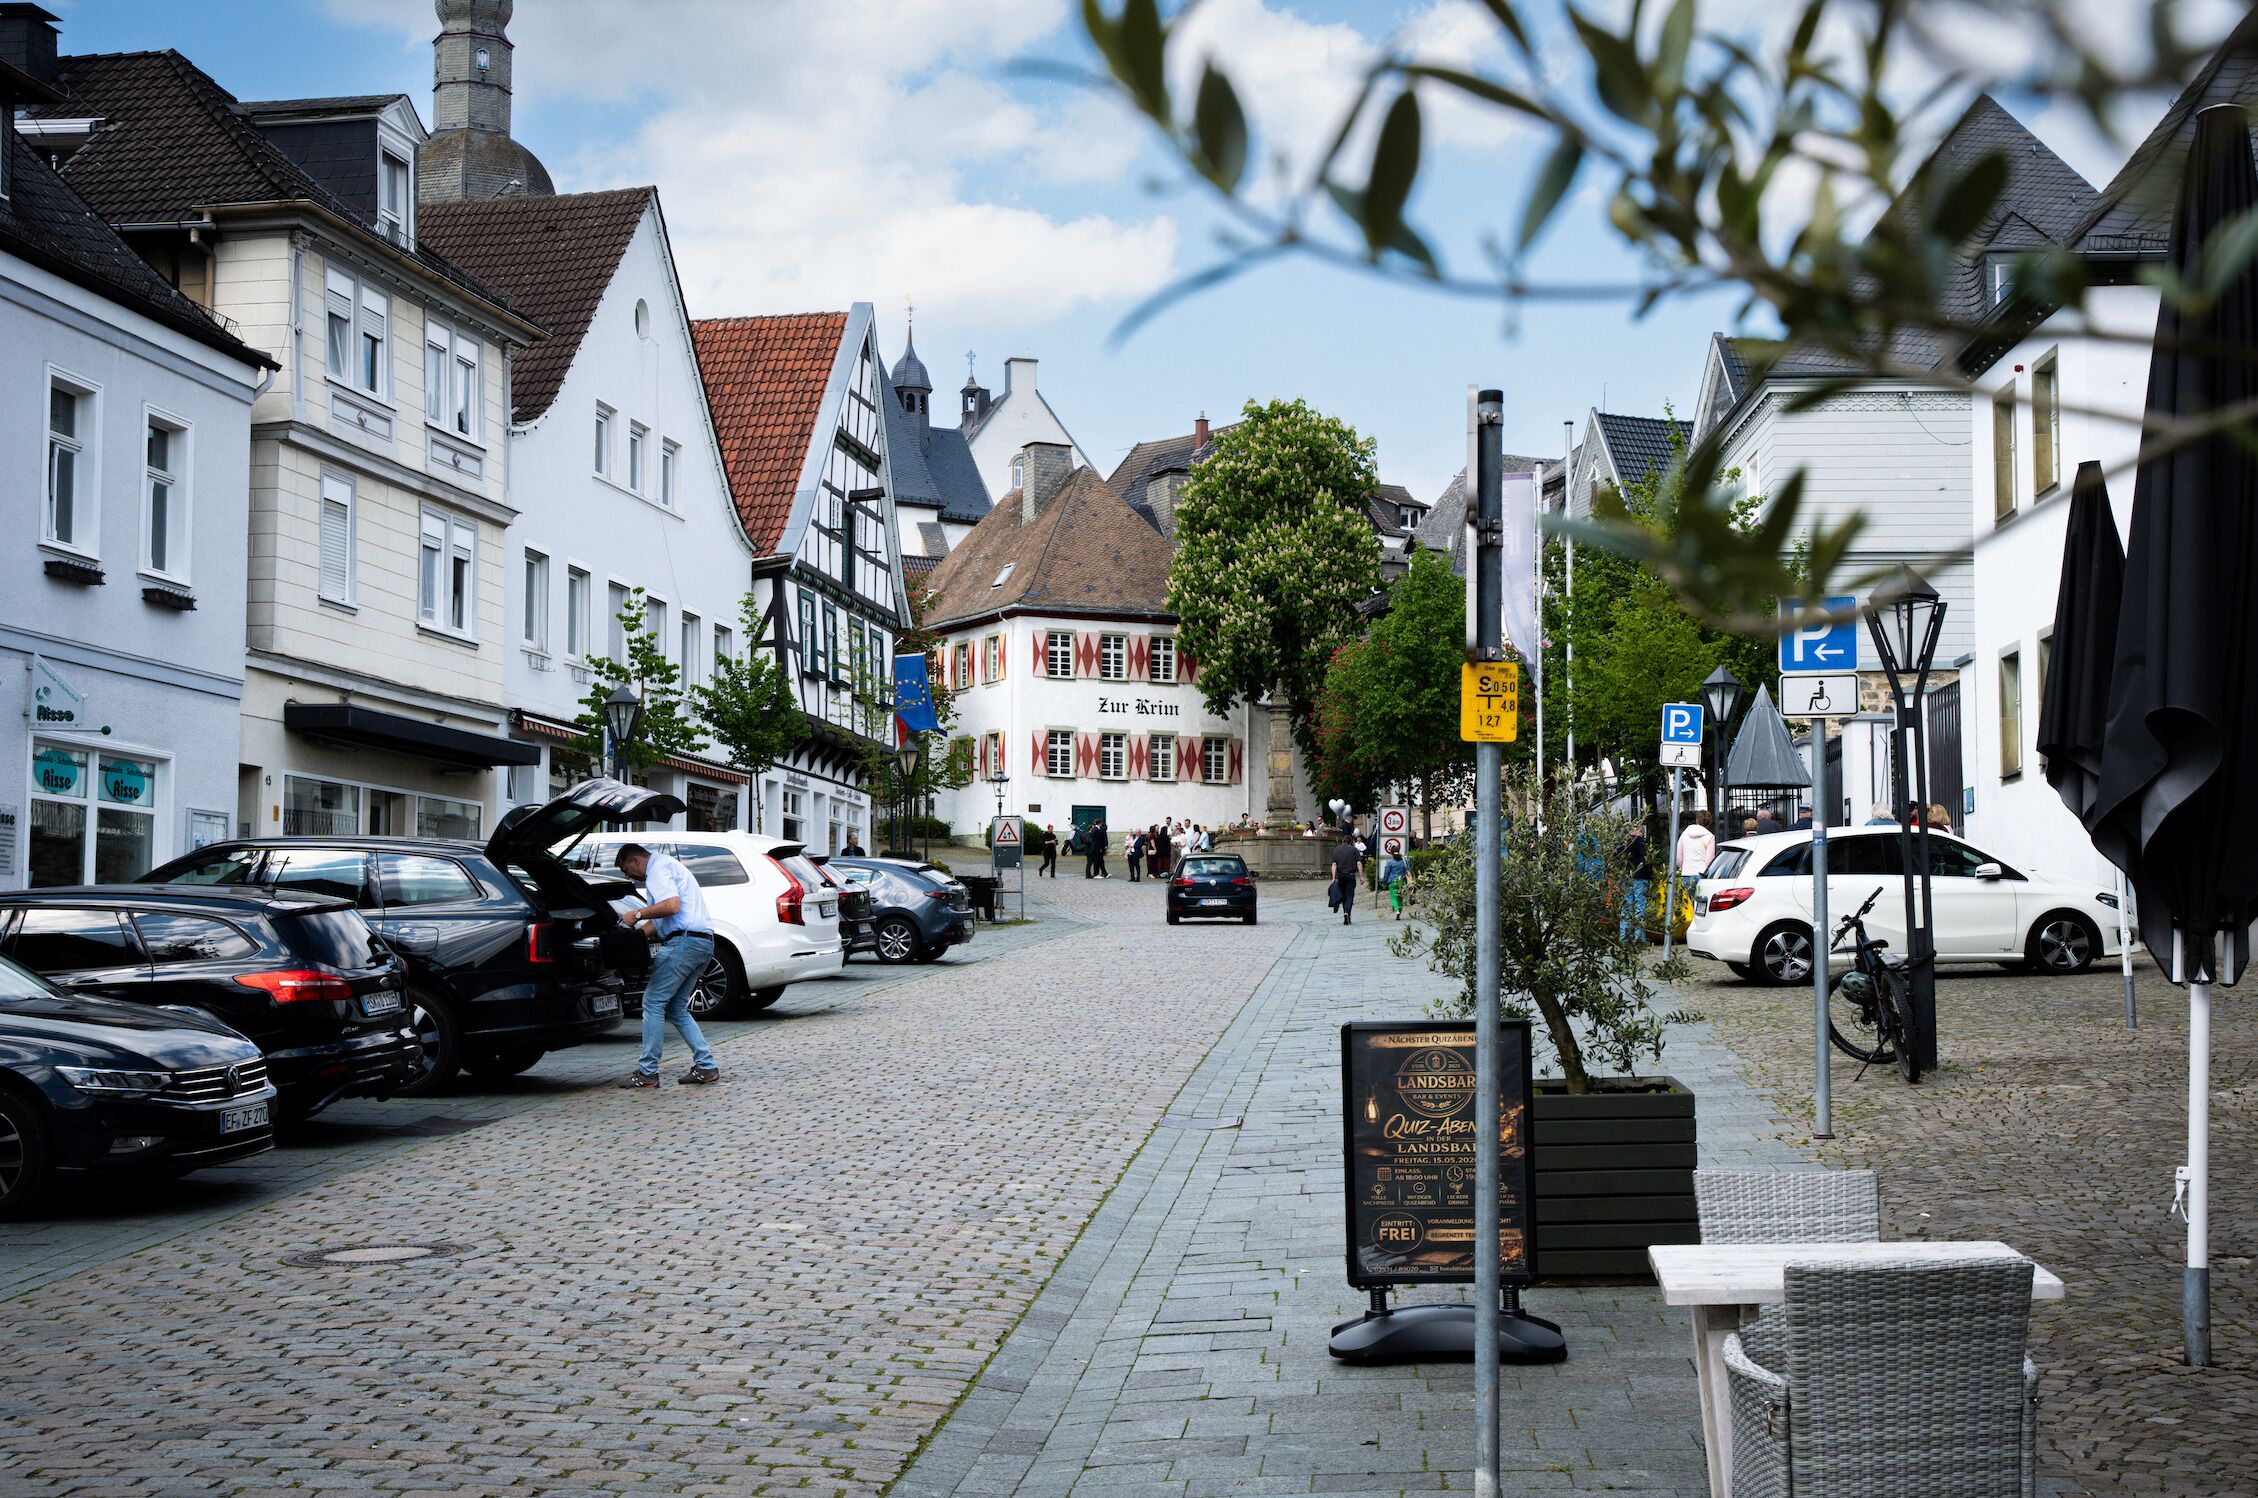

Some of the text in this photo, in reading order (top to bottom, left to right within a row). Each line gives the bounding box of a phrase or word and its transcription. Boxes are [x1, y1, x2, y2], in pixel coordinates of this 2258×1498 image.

[1793, 607, 1833, 662] P
[1493, 681, 1516, 693] 050
[36, 705, 75, 722] Risse
[1097, 697, 1180, 716] Zur Krim
[1669, 709, 1689, 737] P
[43, 769, 72, 789] Risse
[113, 779, 140, 800] Risse
[1397, 1076, 1476, 1089] LANDSBAR
[226, 1113, 238, 1130] EF
[242, 1109, 253, 1127] ZF
[1383, 1113, 1476, 1140] QUIZ-ABEN
[1394, 1157, 1432, 1165] FREITAG,
[1379, 1228, 1416, 1241] FREI
